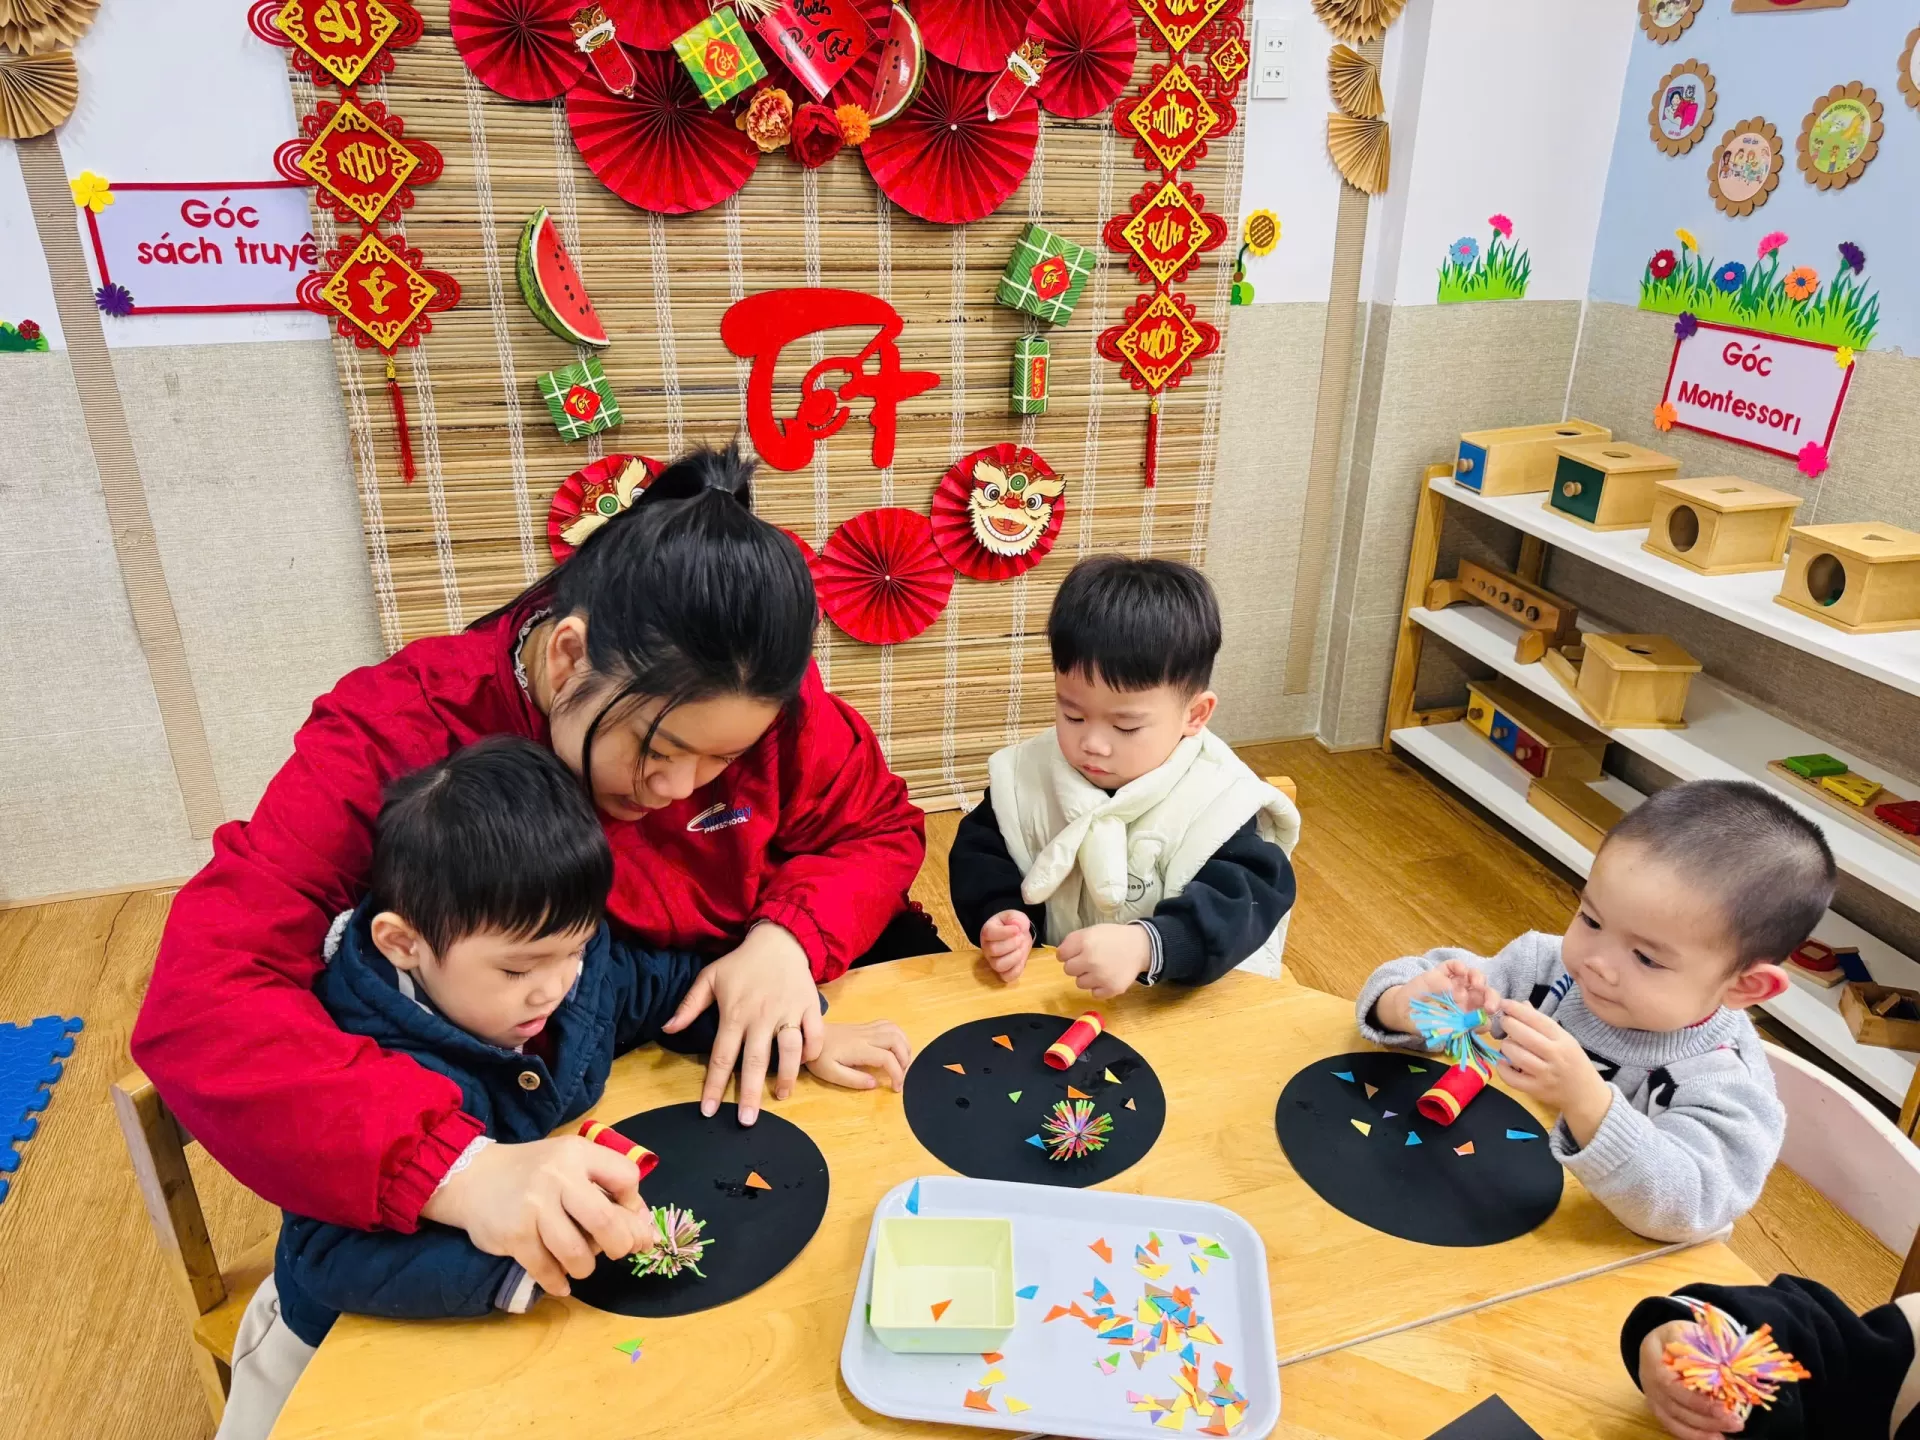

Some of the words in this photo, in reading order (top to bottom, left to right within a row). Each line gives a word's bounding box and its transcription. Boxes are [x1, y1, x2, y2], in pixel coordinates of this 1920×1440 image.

[1152, 93, 1194, 139] MỪNG
[181, 196, 260, 229] Góc
[1148, 211, 1186, 254] NĂM
[137, 232, 223, 265] sách
[234, 231, 319, 275] truyệ
[1139, 320, 1177, 360] MỚI
[1722, 341, 1774, 378] Góc
[720, 287, 941, 472] Tết
[1677, 380, 1802, 436] Montessori
[704, 817, 749, 834] PRESCHOOL
